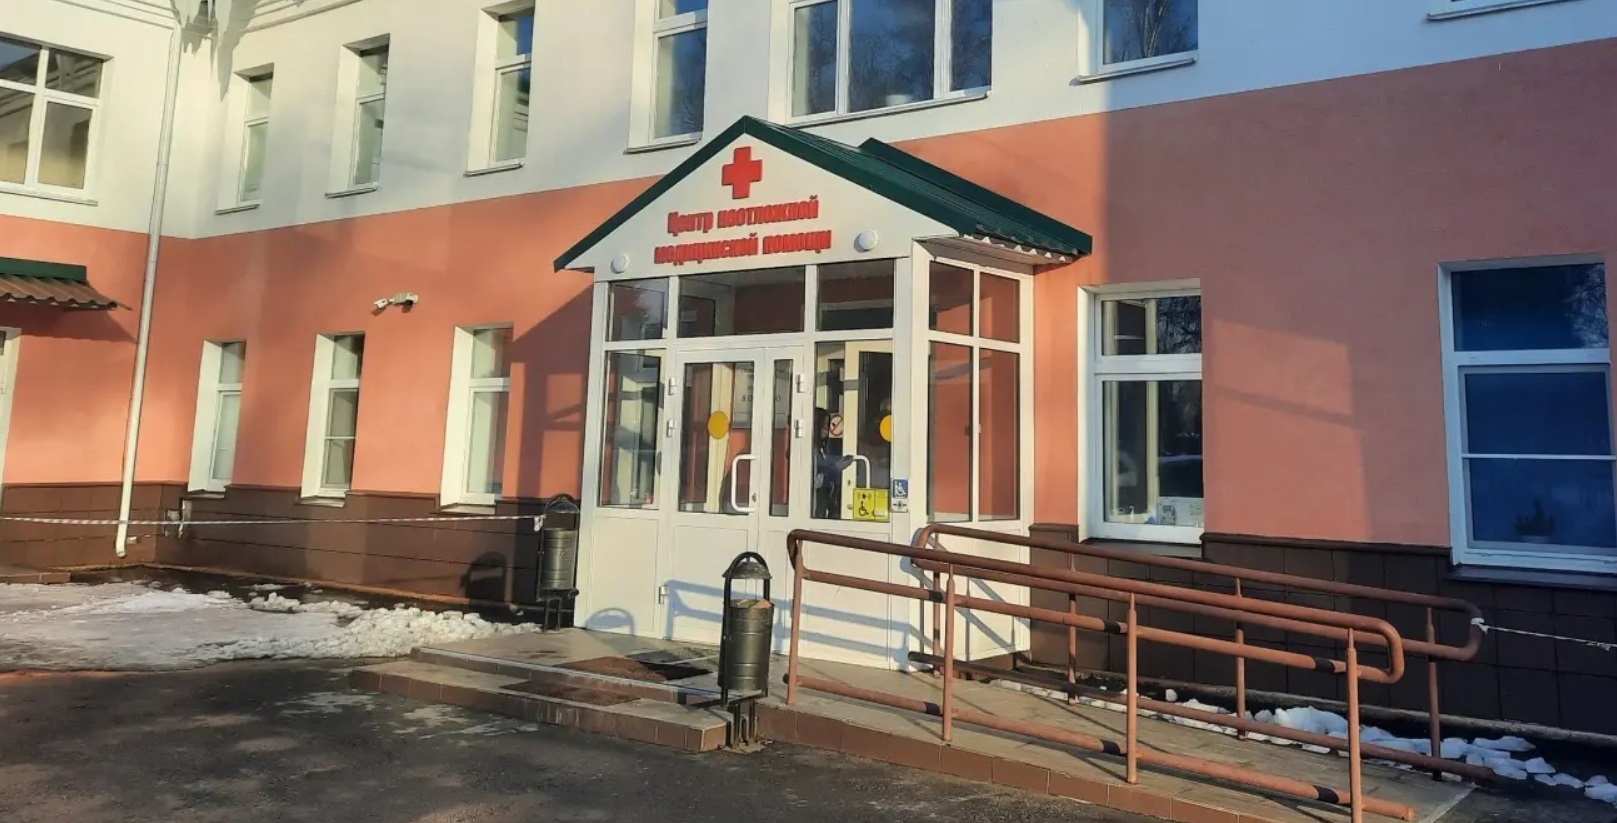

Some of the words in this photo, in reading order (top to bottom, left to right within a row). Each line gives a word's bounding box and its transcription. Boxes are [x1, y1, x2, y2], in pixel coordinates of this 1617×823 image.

[667, 211, 714, 237] Центр
[717, 195, 819, 229] неотложной
[654, 232, 759, 265] медицинской
[762, 230, 832, 254] помощи
